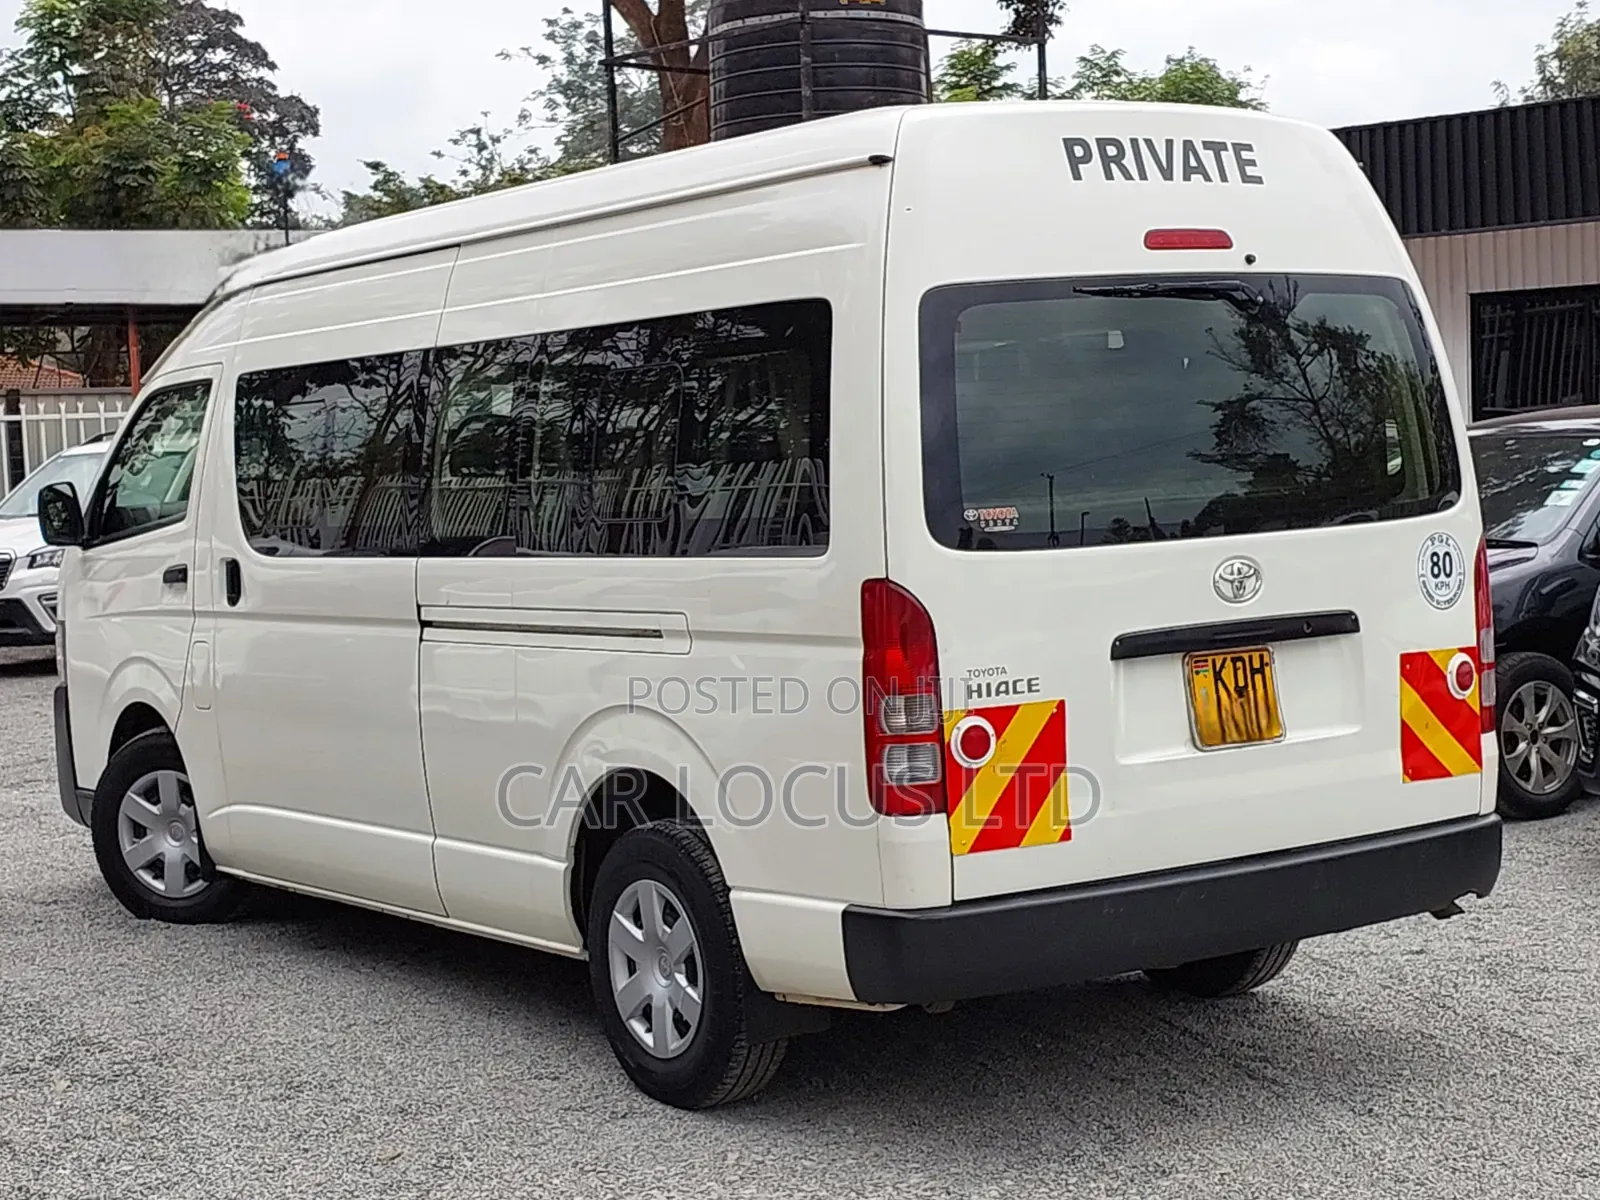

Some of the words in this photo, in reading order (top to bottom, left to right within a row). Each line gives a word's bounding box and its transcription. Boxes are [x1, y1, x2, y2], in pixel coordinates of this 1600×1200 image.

[1062, 137, 1264, 185] PRIVATE
[978, 507, 1018, 519] TOYOTA
[1429, 534, 1452, 547] PGL
[1430, 551, 1453, 579] 80
[1434, 580, 1451, 591] KPH
[966, 666, 1007, 678] TOYOTA
[966, 677, 1041, 700] HIACE
